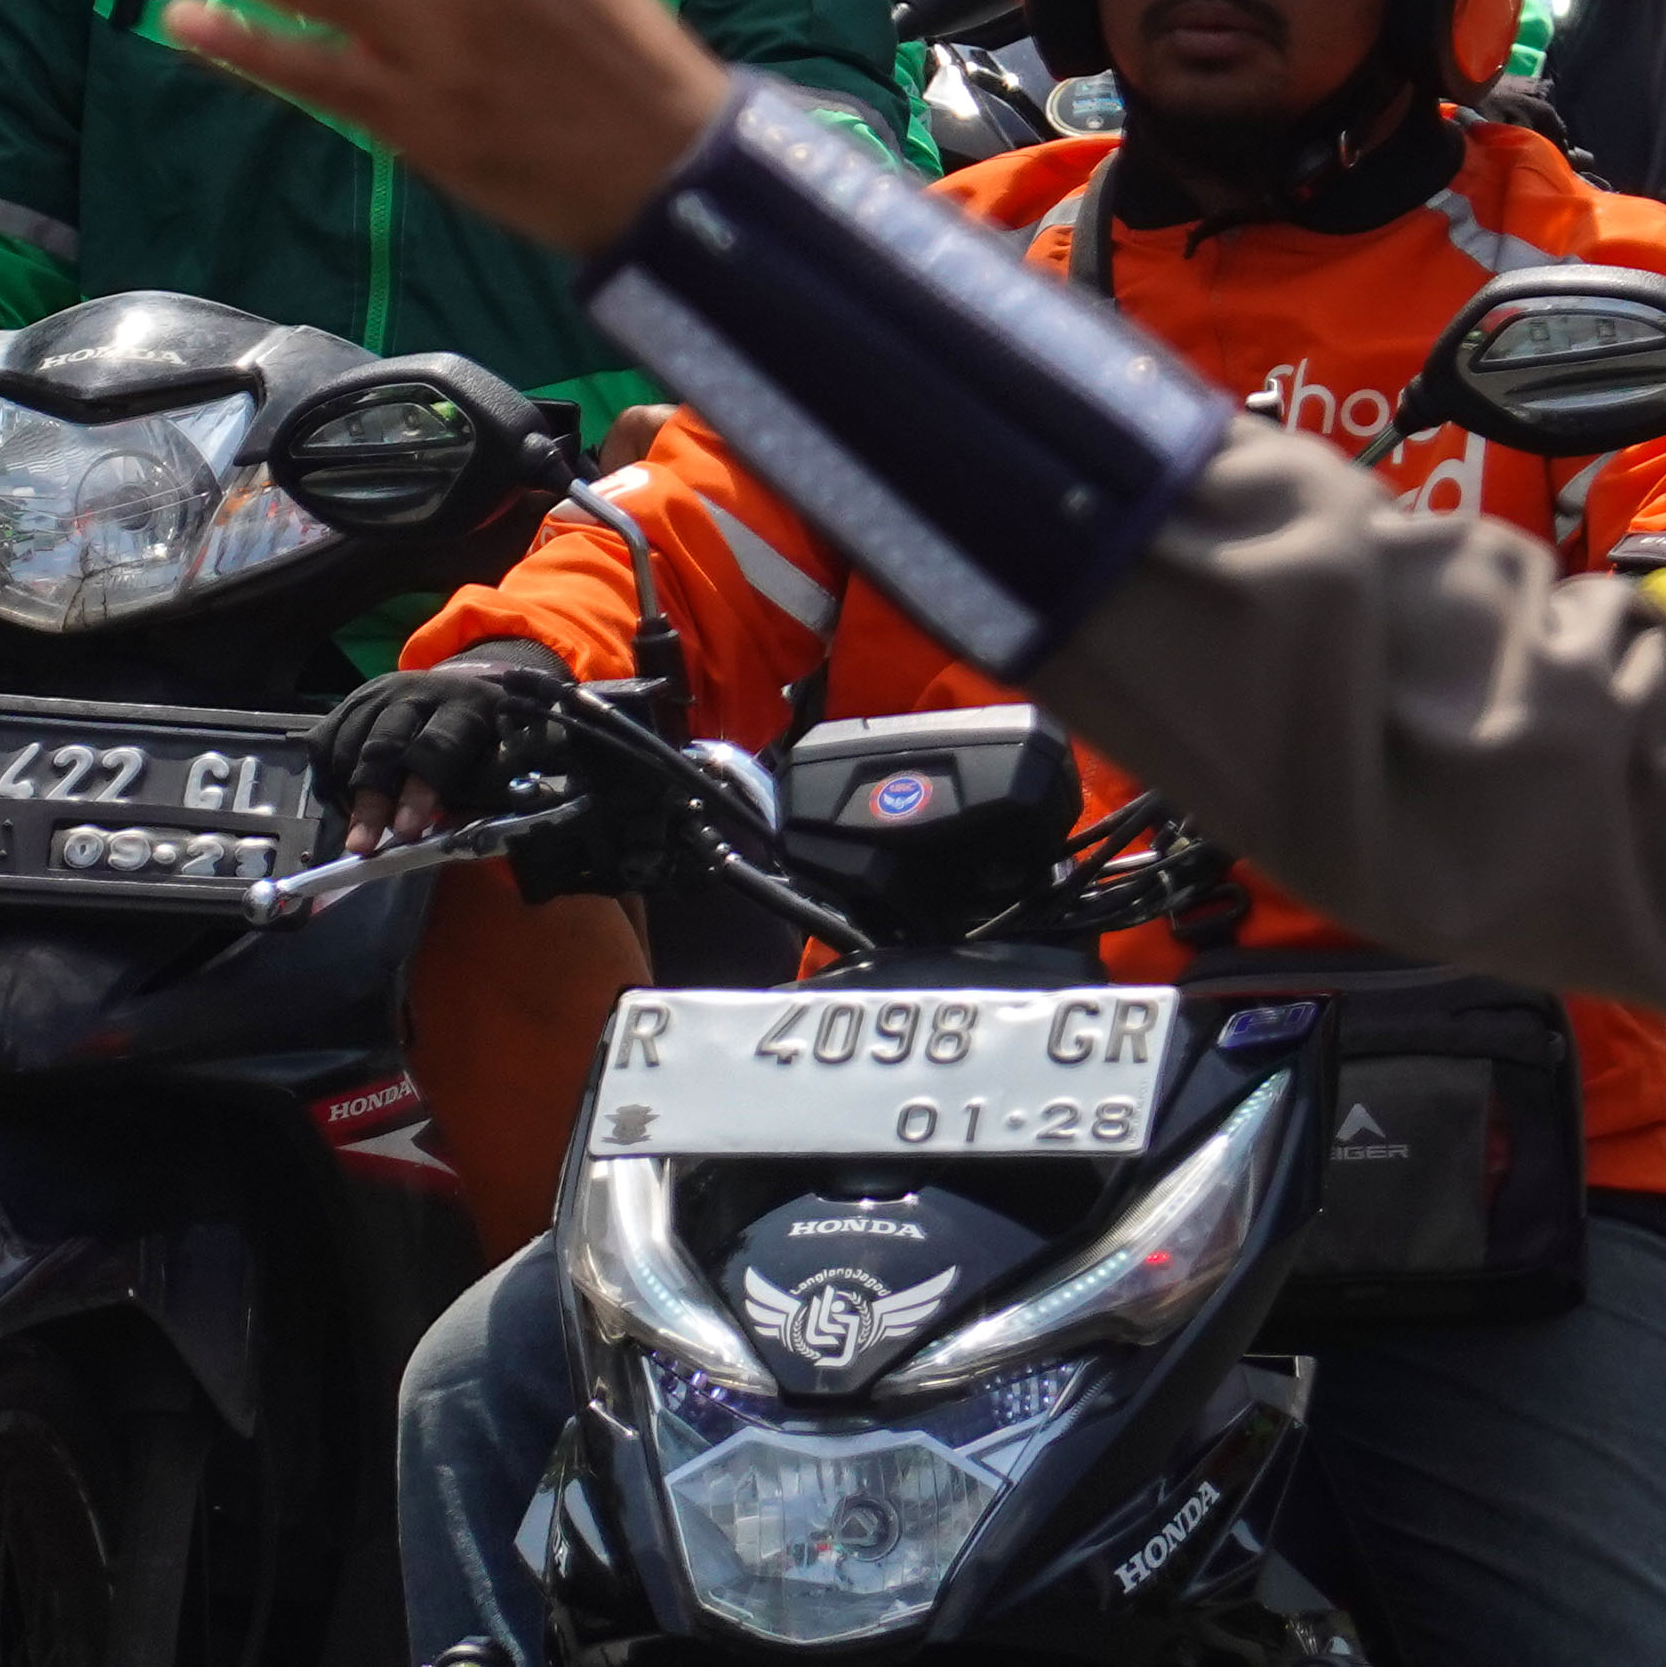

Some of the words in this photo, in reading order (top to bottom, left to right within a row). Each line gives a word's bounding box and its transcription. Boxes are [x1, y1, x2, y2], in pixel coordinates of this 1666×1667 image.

[184, 751, 279, 816] GL
[613, 1003, 672, 1069] R
[754, 1001, 983, 1066] 4098
[1044, 998, 1161, 1066] GR
[328, 1079, 413, 1122] HONDA
[787, 1216, 928, 1240] HONDA
[1114, 1480, 1221, 1594] HONDA
